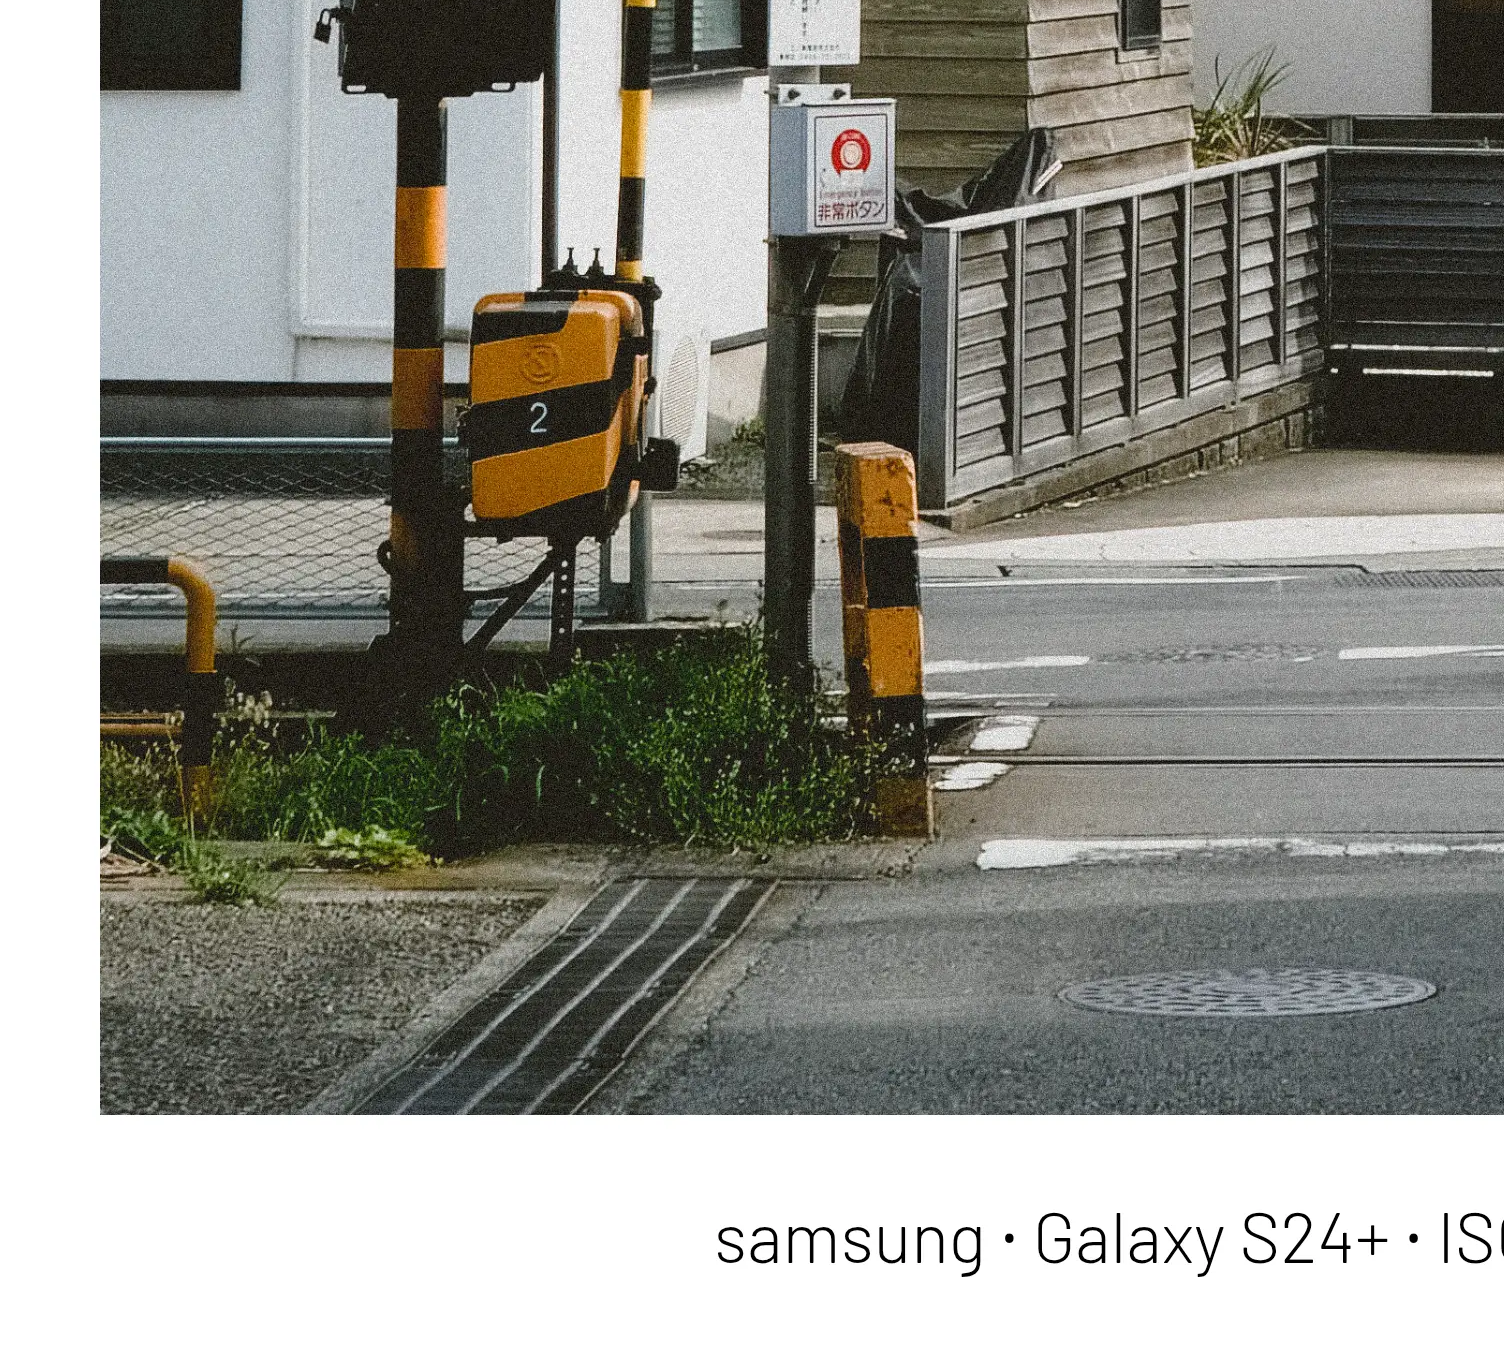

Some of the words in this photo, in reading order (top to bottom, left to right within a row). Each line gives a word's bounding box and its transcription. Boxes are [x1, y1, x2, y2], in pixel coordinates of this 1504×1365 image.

[818, 201, 885, 222] 非常ボタン
[529, 401, 548, 434] 2
